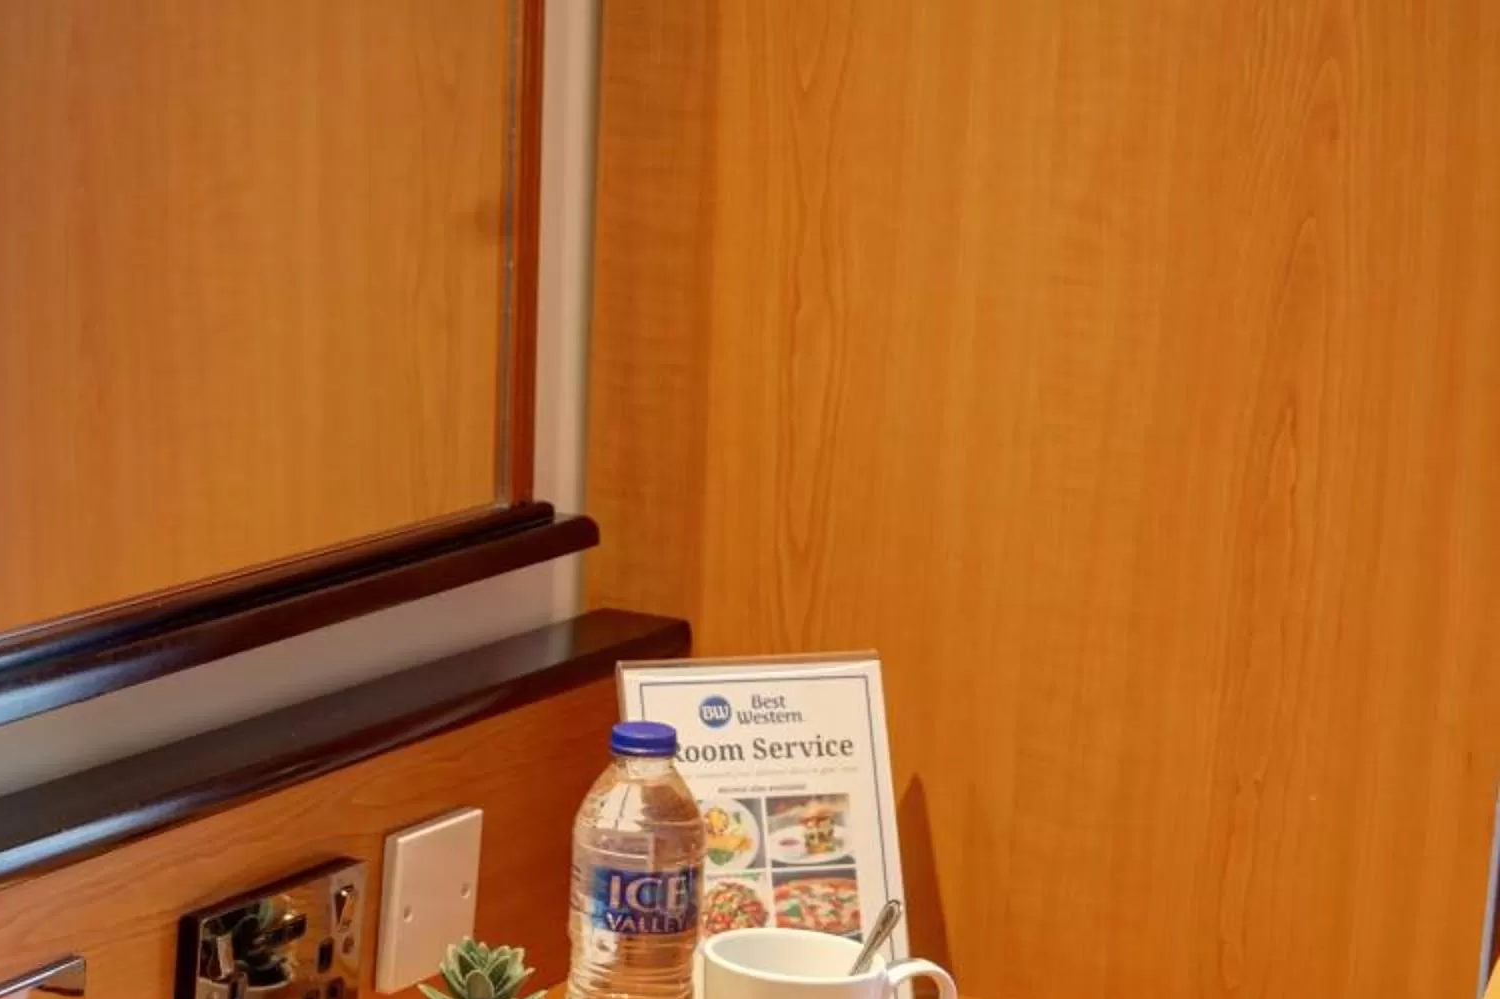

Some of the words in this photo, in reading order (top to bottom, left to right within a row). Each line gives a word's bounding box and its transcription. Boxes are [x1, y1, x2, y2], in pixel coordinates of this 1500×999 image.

[751, 694, 786, 709] Best
[753, 735, 854, 760] Service
[608, 875, 688, 913] ICE
